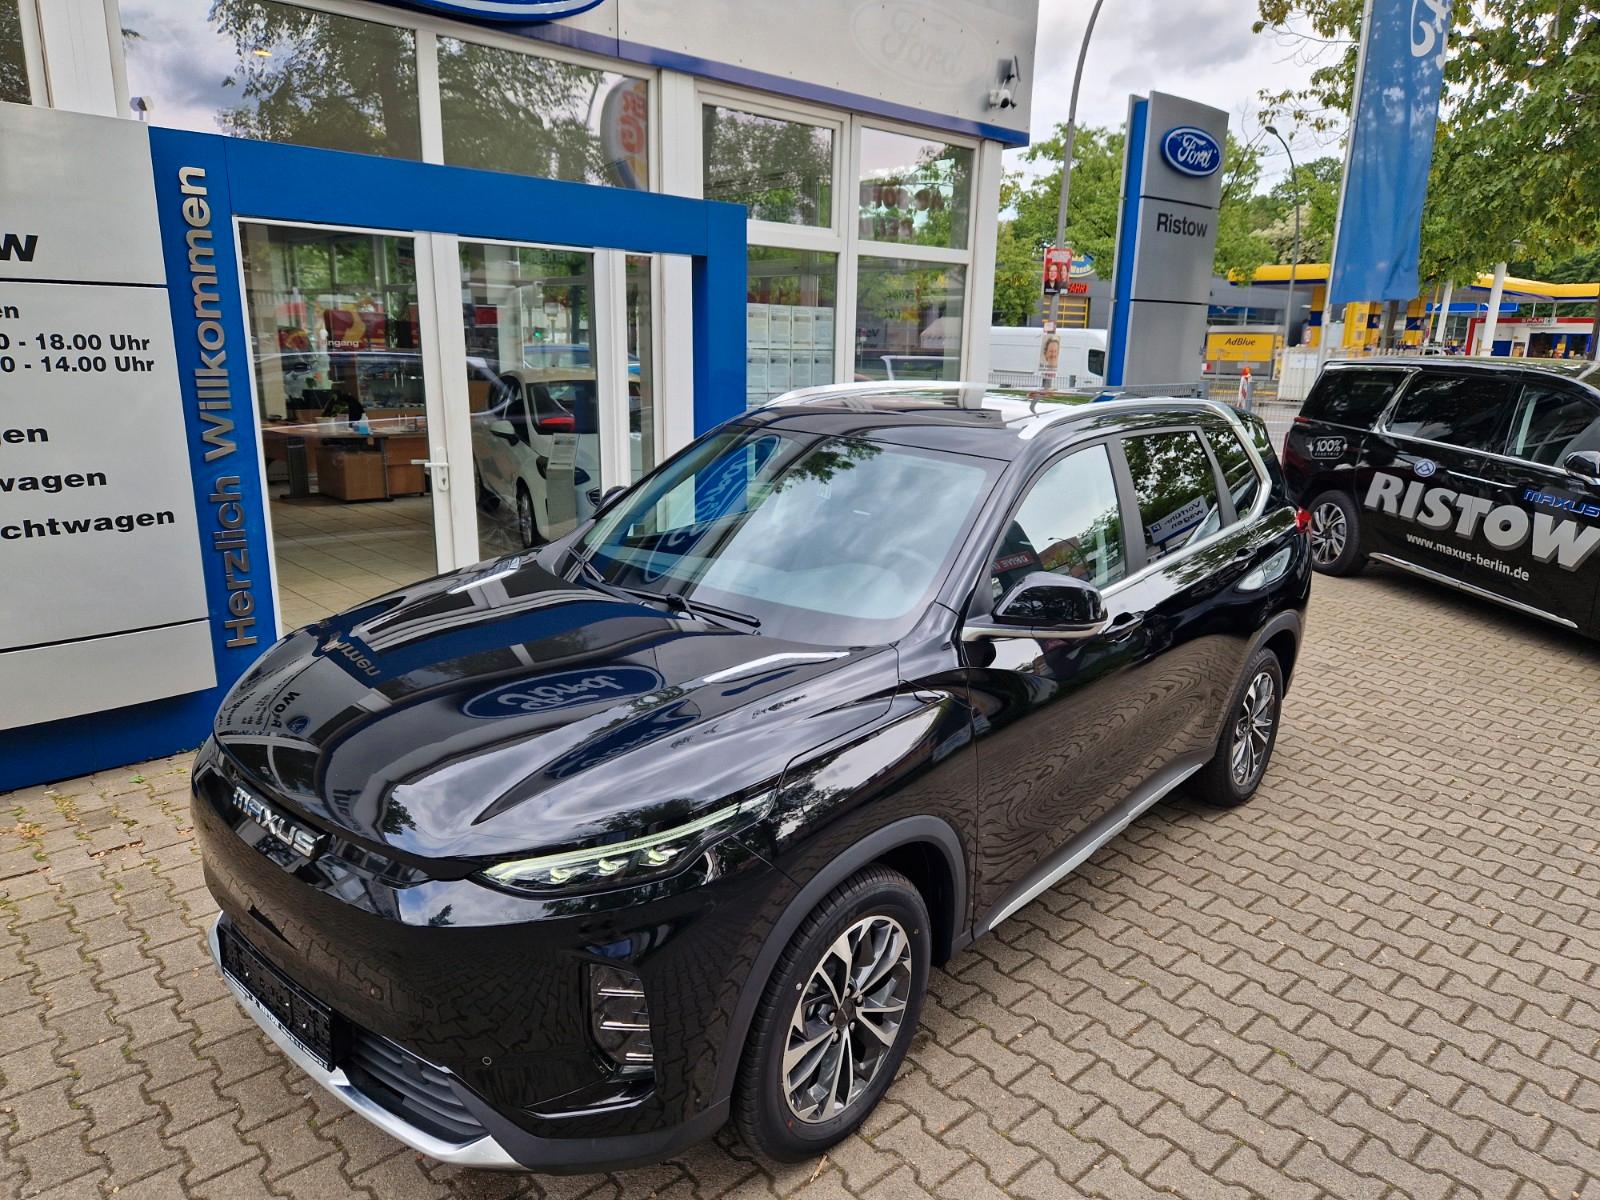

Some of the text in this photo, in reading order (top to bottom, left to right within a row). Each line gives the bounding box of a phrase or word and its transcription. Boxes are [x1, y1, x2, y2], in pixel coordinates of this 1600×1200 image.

[1177, 133, 1214, 169] Ford
[1156, 212, 1208, 238] Ristow
[178, 166, 238, 462] Willkommen
[35, 333, 102, 351] 18.00
[109, 334, 150, 351] Uhr
[1224, 337, 1256, 346] AdBlue
[40, 356, 107, 372] 14.00
[114, 356, 154, 372] Uhr
[0, 427, 49, 444] en
[1316, 439, 1343, 452] 100%
[1523, 489, 1600, 518] MAXUS
[0, 510, 175, 540] chtwagen
[1363, 471, 1600, 573] RISTOW
[208, 475, 259, 649] Herzlich
[1406, 533, 1530, 581] www.maxus-berlin.de
[232, 785, 318, 858] MAXUS
